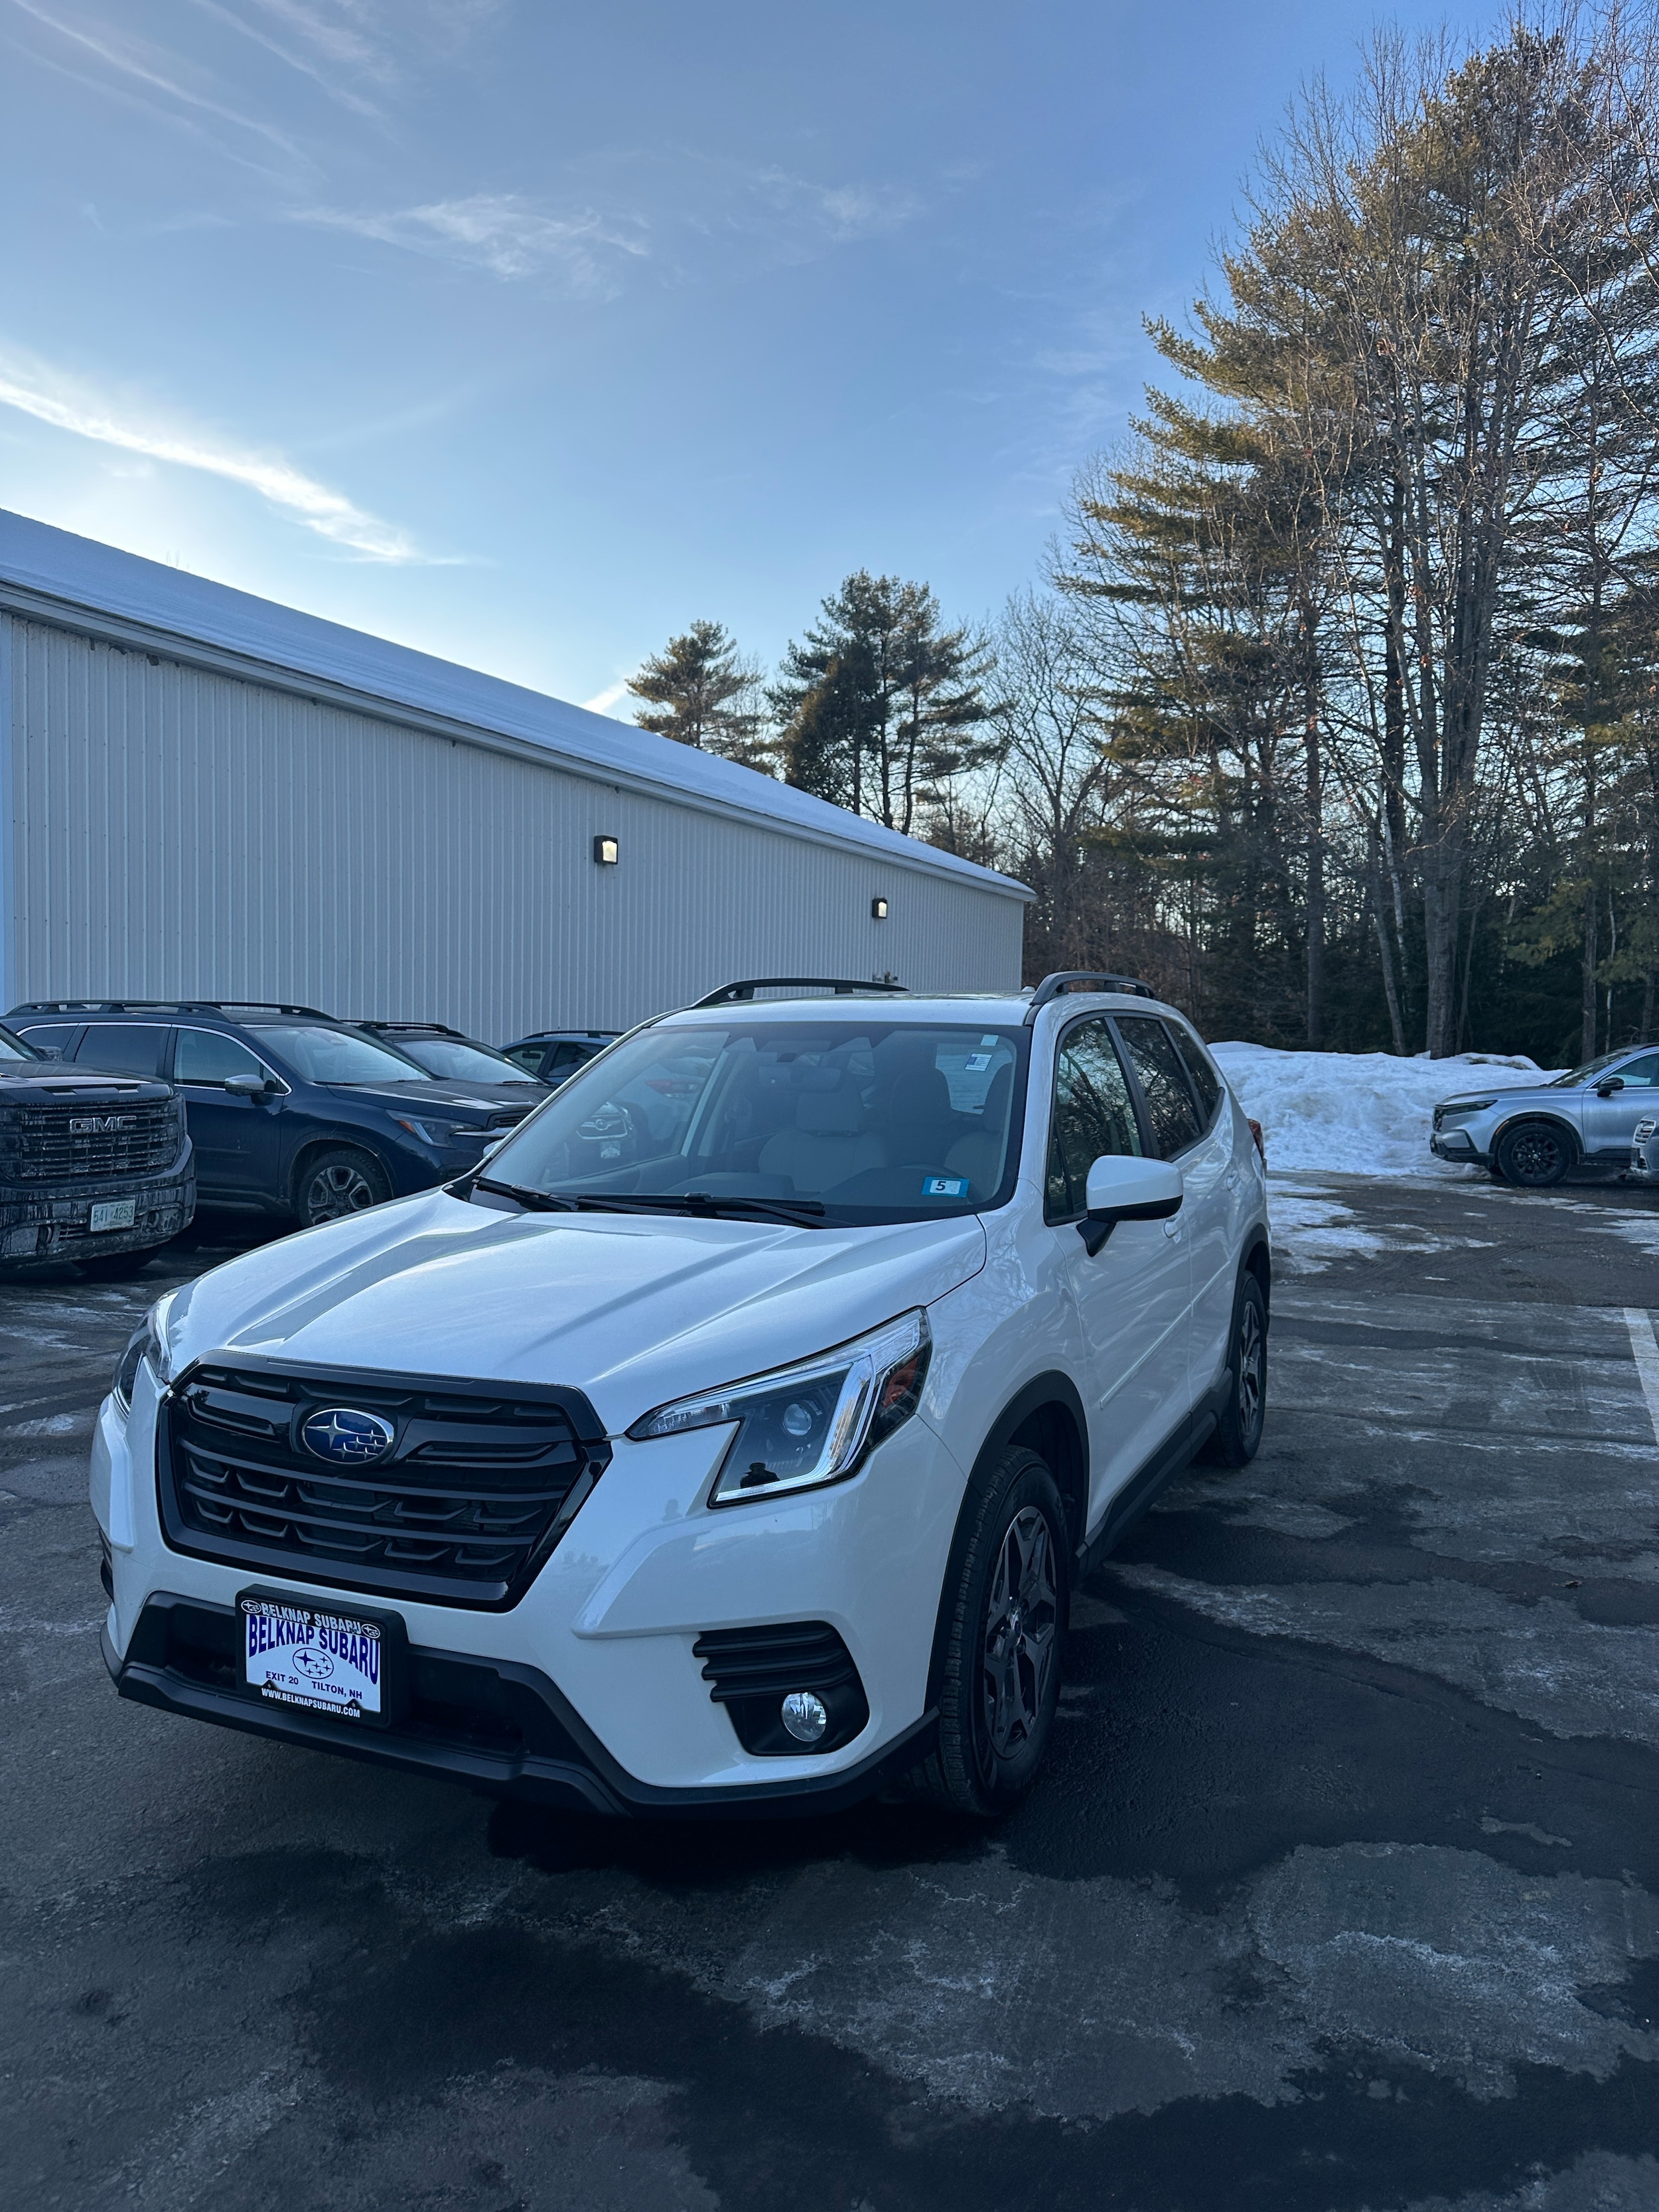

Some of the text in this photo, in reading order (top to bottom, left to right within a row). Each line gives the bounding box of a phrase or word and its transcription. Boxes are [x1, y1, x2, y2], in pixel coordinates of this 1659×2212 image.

[70, 1116, 137, 1134] GMC
[936, 1181, 946, 1191] 5
[94, 1205, 134, 1222] 541 4253
[261, 1603, 362, 1635] BELKNAP SUBARU
[249, 1614, 379, 1684] BELKNAP SUBARU
[266, 1670, 299, 1684] EXIT 20
[312, 1680, 362, 1699] TILTON, NH
[261, 1688, 360, 1718] WWW.BELKNAPSUBARU.COM
